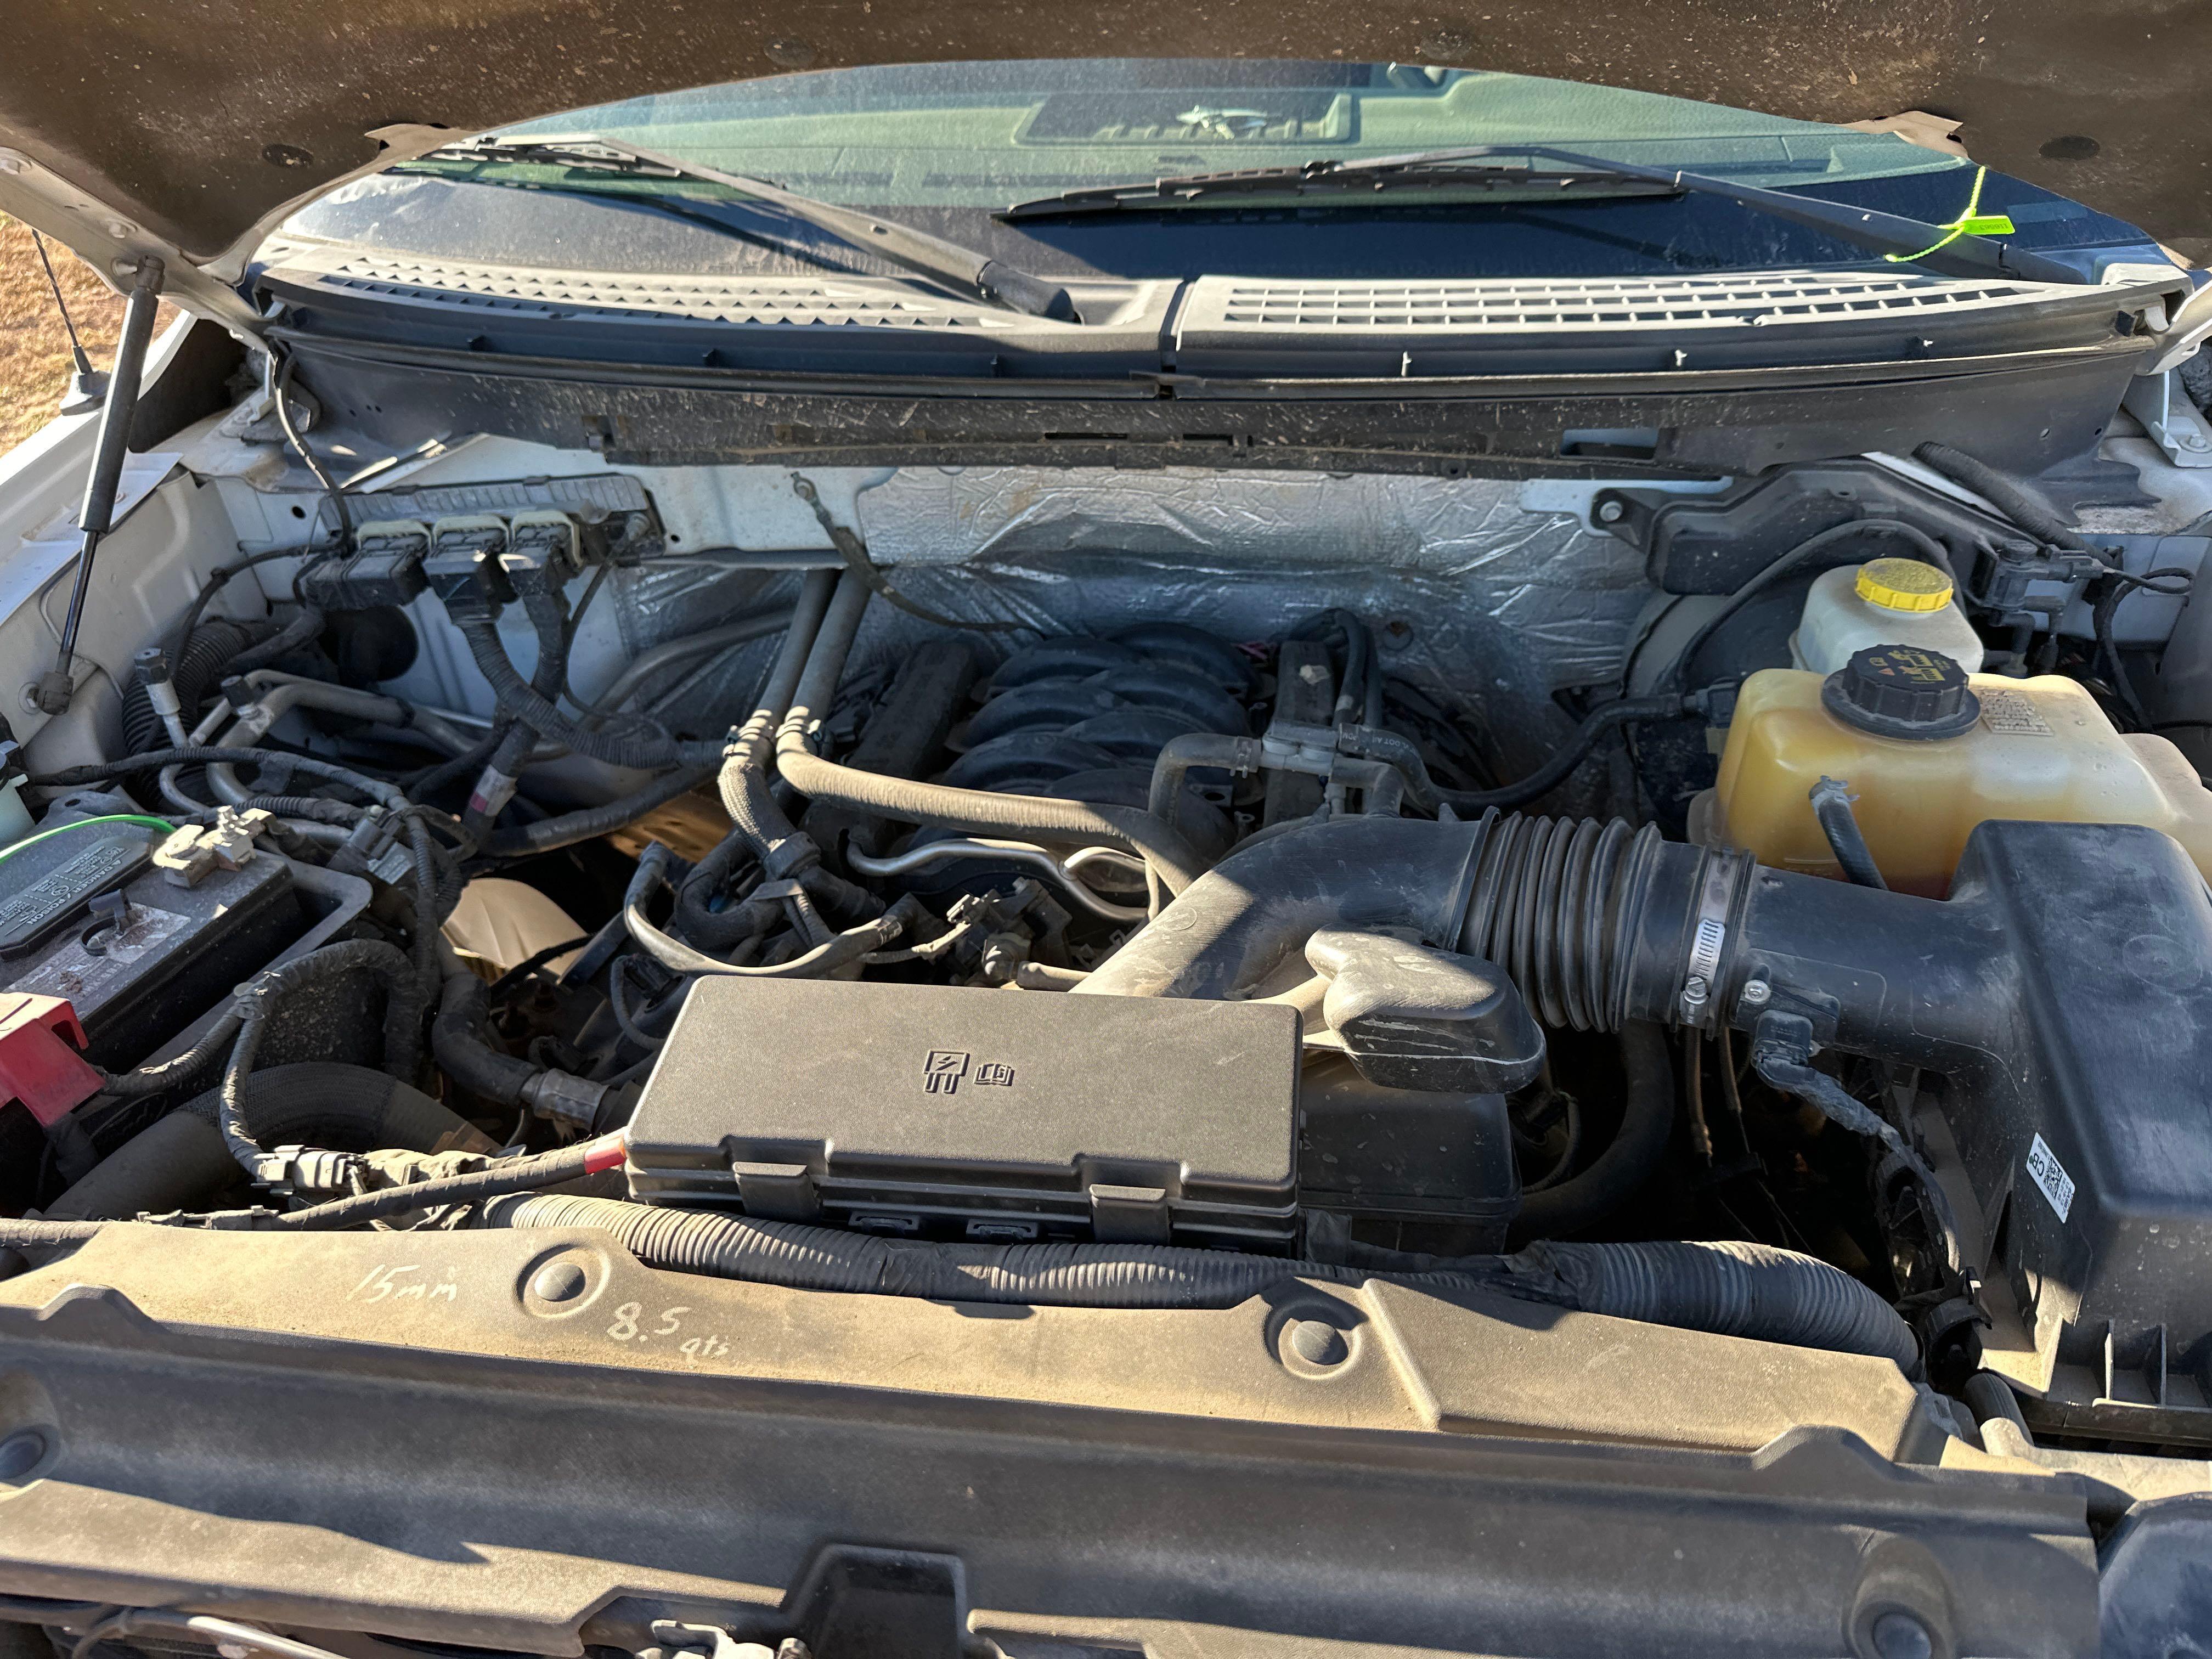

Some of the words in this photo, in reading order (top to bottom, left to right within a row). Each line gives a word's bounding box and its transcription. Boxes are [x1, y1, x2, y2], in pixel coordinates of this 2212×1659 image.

[71, 866, 114, 893] DANGER
[27, 898, 66, 925] POISON
[2032, 1152, 2045, 1177] CB
[344, 1263, 458, 1304] 15mm
[606, 1301, 691, 1342] 8.5
